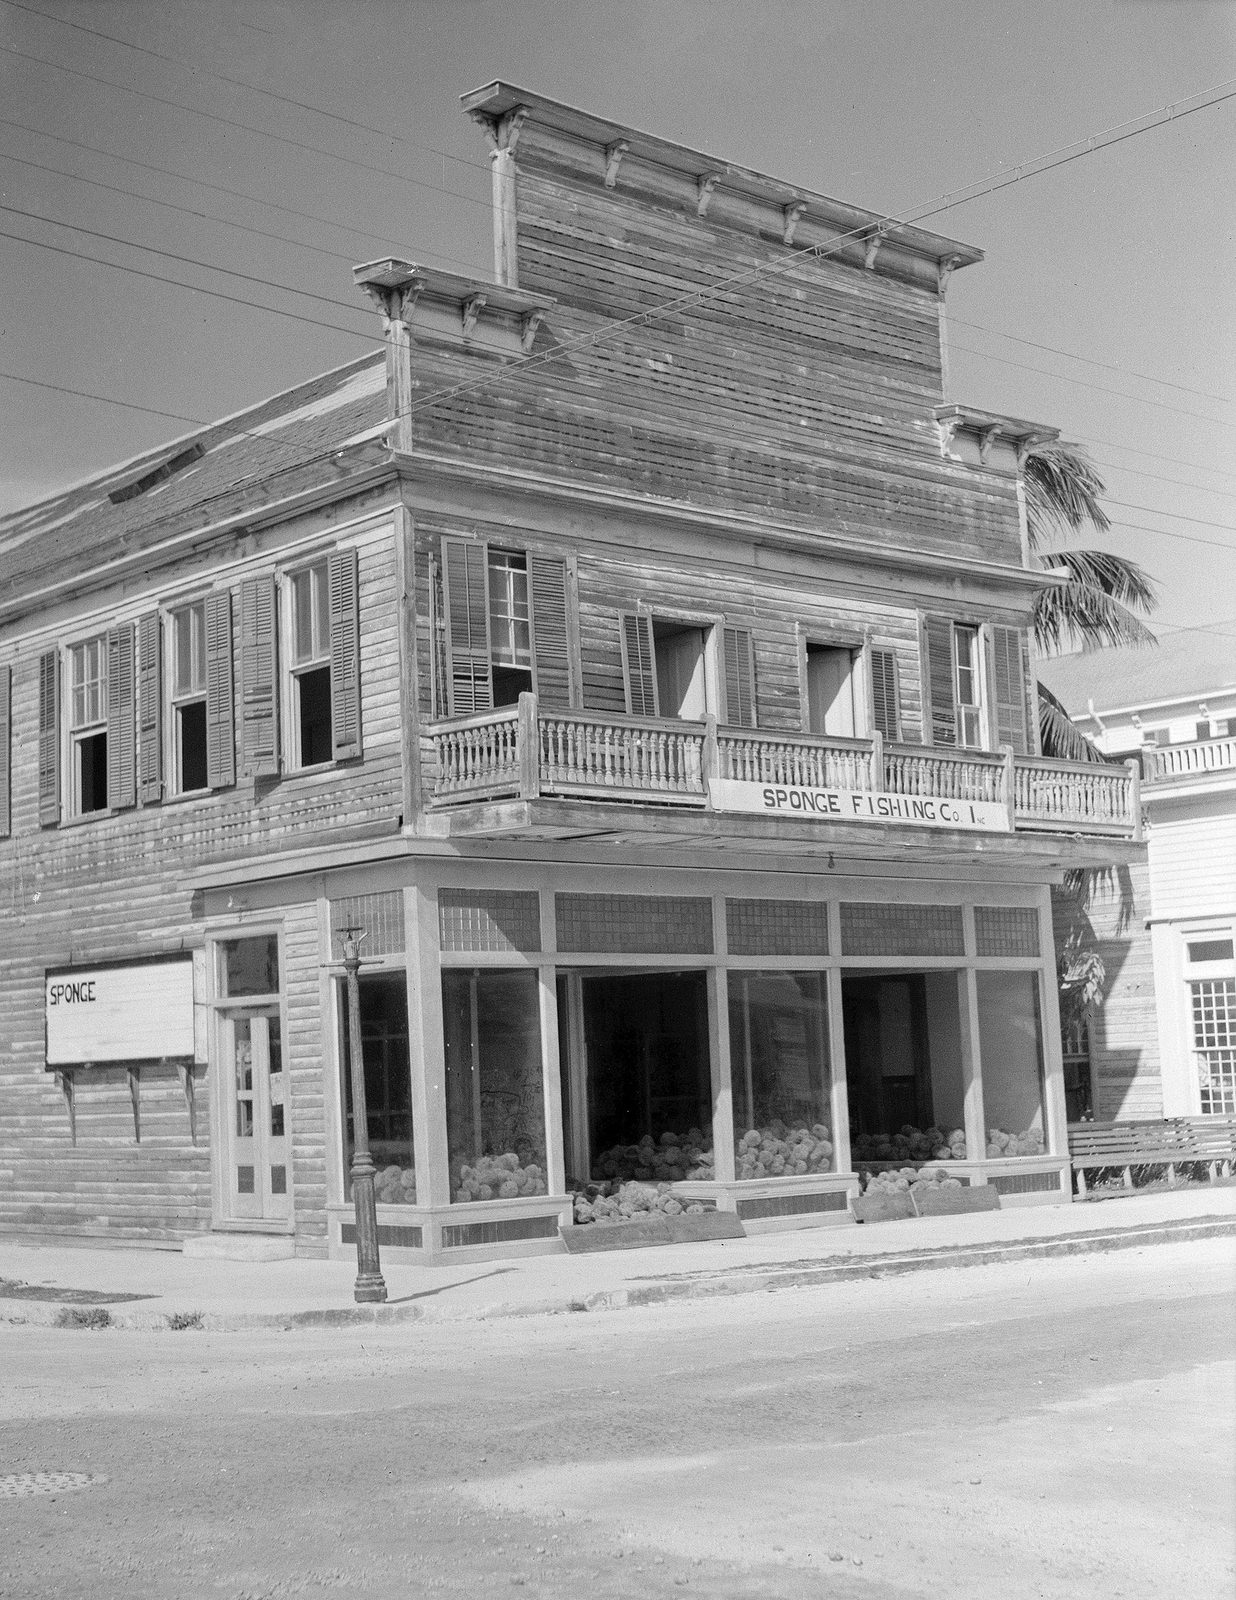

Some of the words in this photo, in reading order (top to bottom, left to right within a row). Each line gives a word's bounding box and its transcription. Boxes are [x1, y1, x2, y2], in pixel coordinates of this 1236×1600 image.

[763, 788, 841, 813] SPONGE
[851, 795, 936, 820] FISHING
[50, 981, 96, 1006] SPONGE
